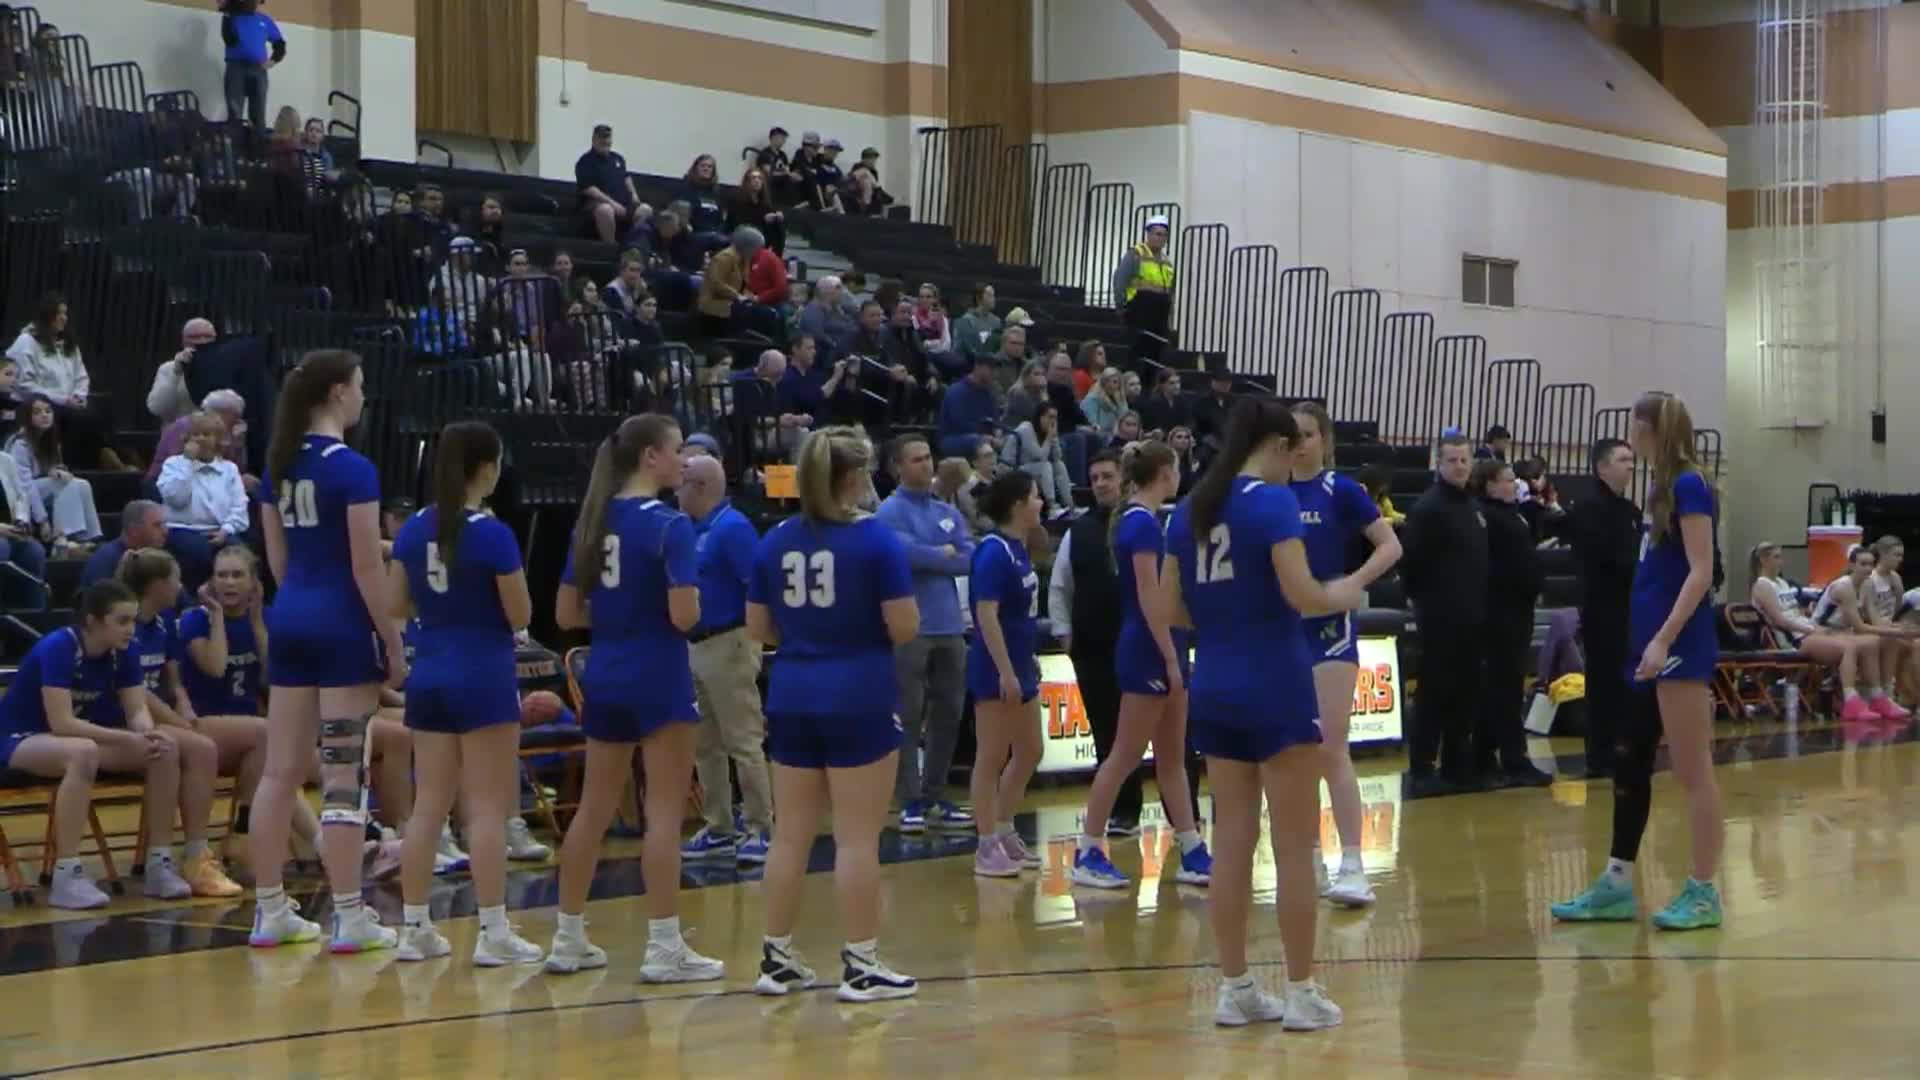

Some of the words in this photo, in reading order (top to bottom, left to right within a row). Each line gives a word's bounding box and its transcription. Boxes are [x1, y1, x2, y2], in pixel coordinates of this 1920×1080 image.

[279, 479, 319, 527] 20
[427, 541, 449, 593] 5
[601, 535, 621, 588] 3
[782, 550, 836, 608] 33
[1196, 523, 1234, 583] 12
[1352, 664, 1394, 714] RS
